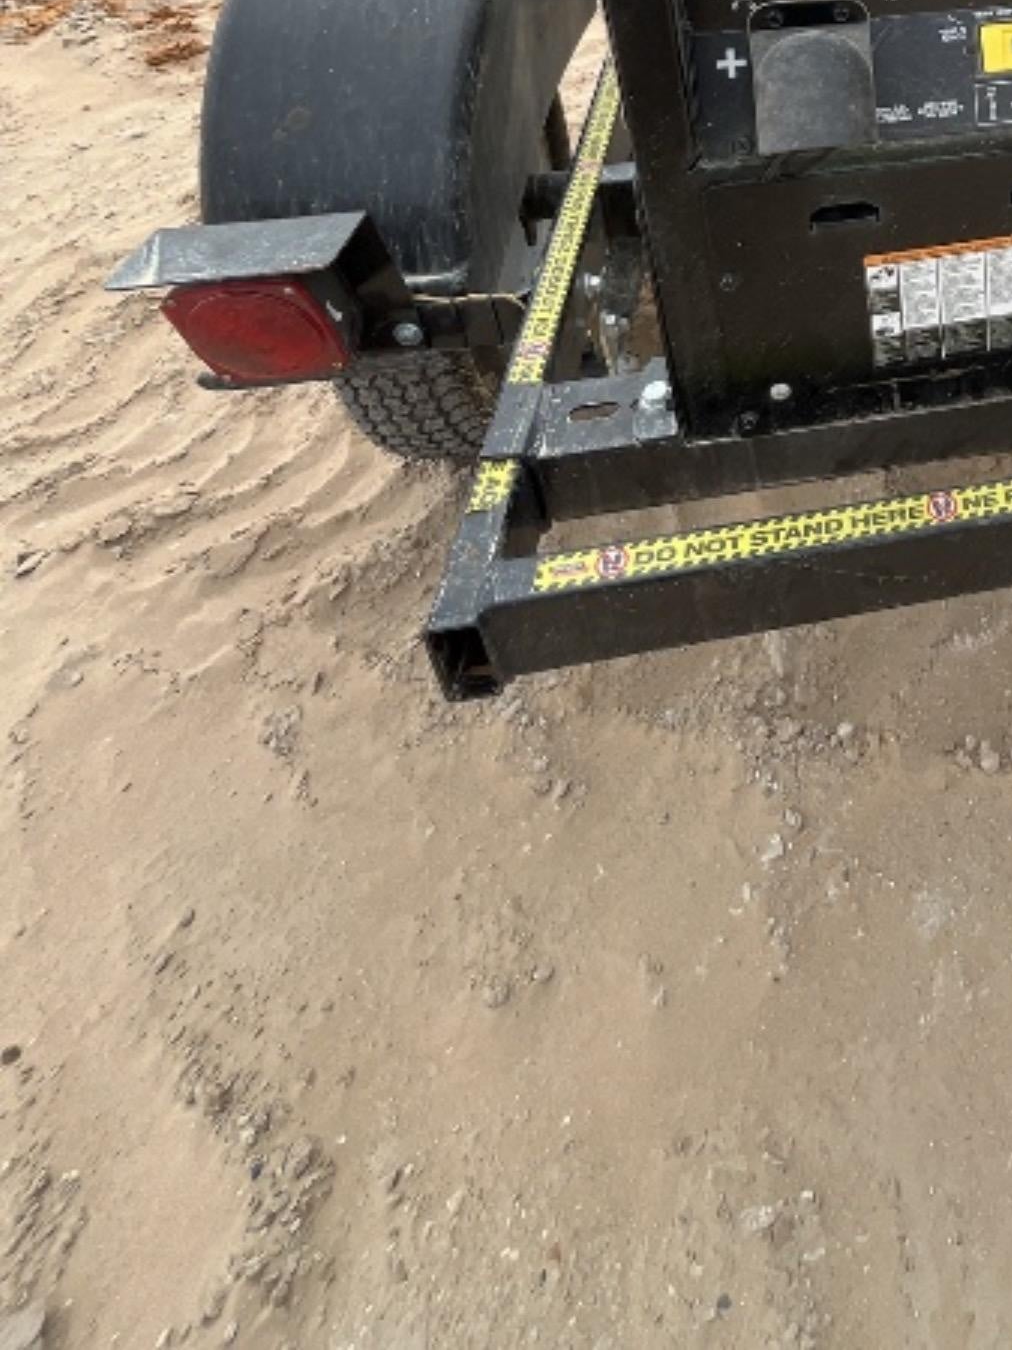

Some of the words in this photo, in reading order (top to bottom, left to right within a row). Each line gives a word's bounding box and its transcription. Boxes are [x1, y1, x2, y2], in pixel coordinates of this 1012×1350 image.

[961, 495, 999, 513] NE
[634, 546, 675, 565] DO
[684, 535, 744, 558] NOT
[750, 518, 844, 547] STAND
[851, 503, 924, 530] HERE
